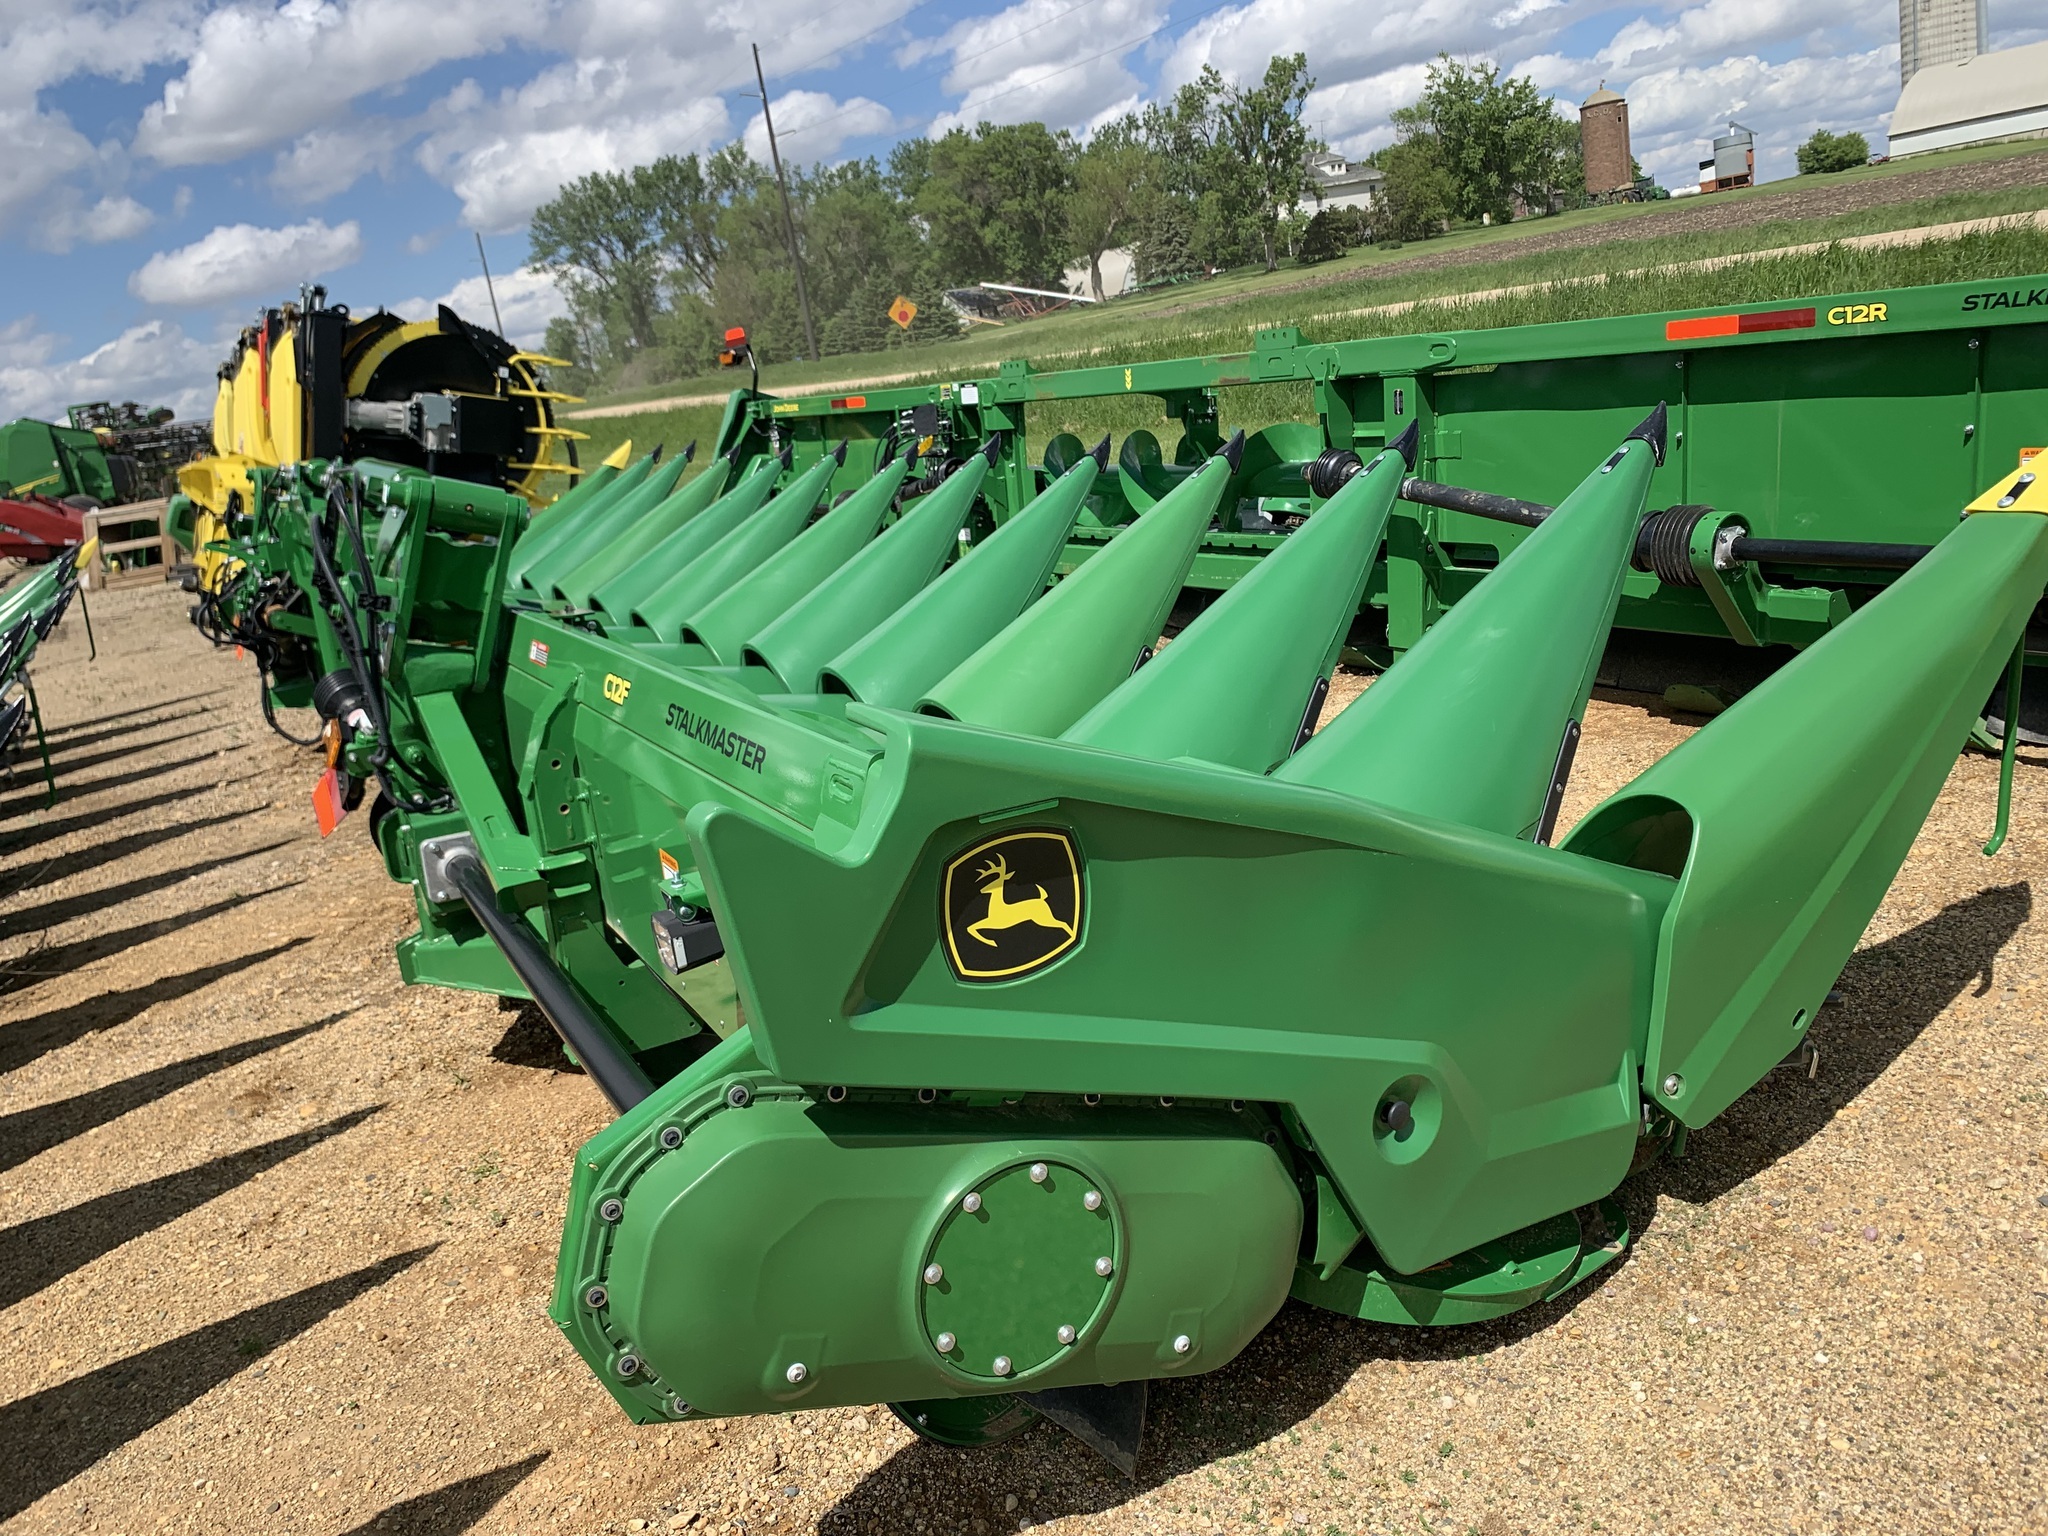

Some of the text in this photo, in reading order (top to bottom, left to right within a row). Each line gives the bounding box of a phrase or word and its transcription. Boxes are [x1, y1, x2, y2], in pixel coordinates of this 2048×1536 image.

[1827, 288, 2048, 325] C12R STALK
[604, 672, 767, 774] C12F STALKMASTER
